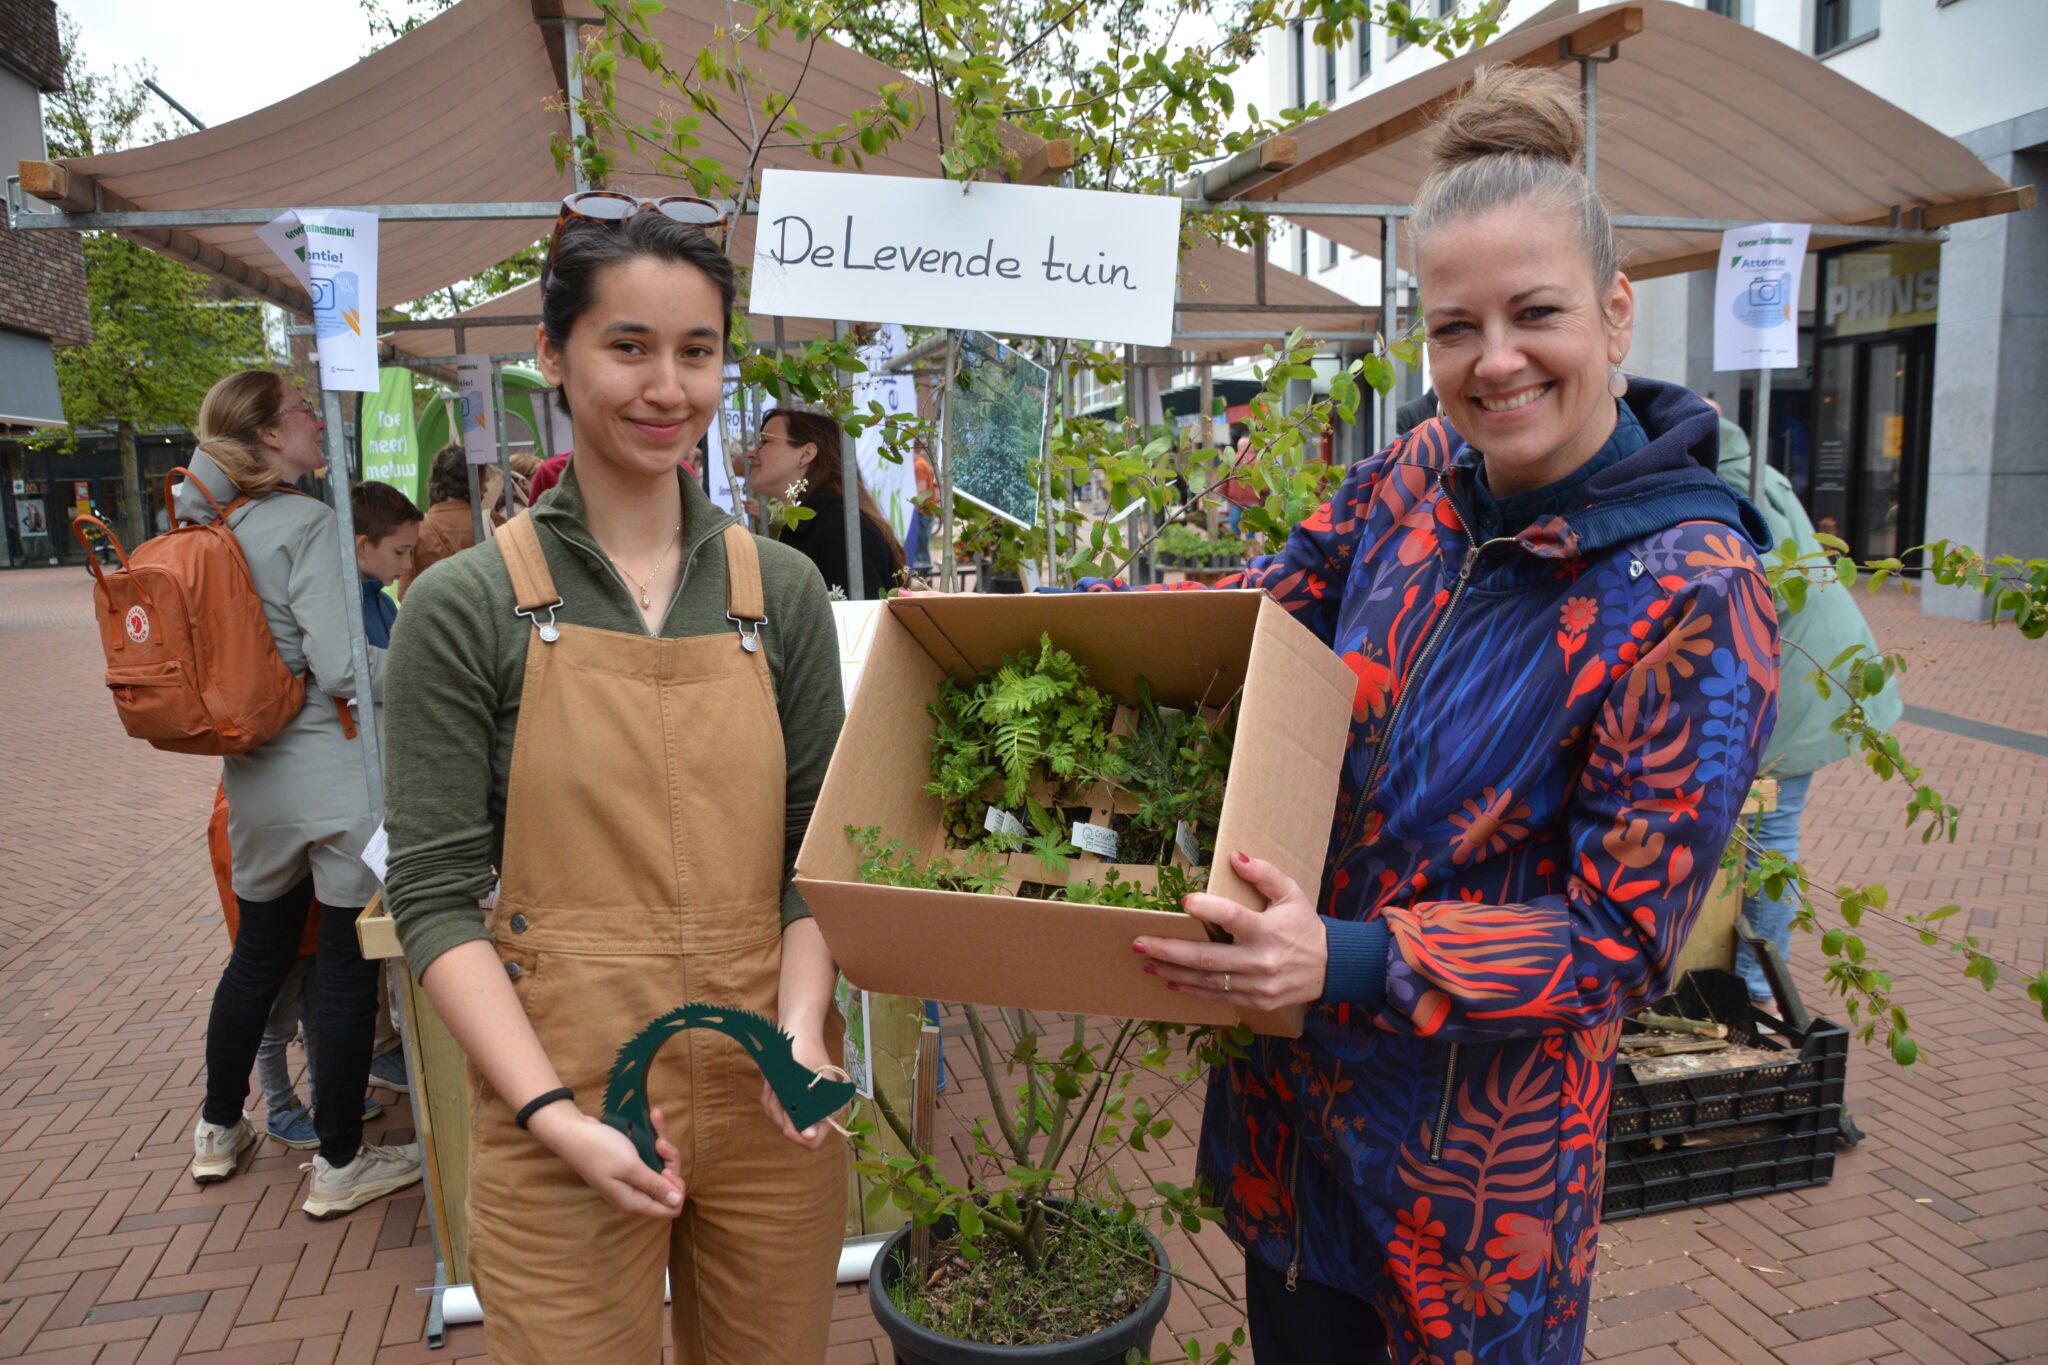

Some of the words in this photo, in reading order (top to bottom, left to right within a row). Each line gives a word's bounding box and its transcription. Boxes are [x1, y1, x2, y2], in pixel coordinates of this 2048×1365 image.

[307, 250, 344, 264] entie!
[1041, 234, 1138, 290] tuin
[1824, 268, 1938, 327] PRINS
